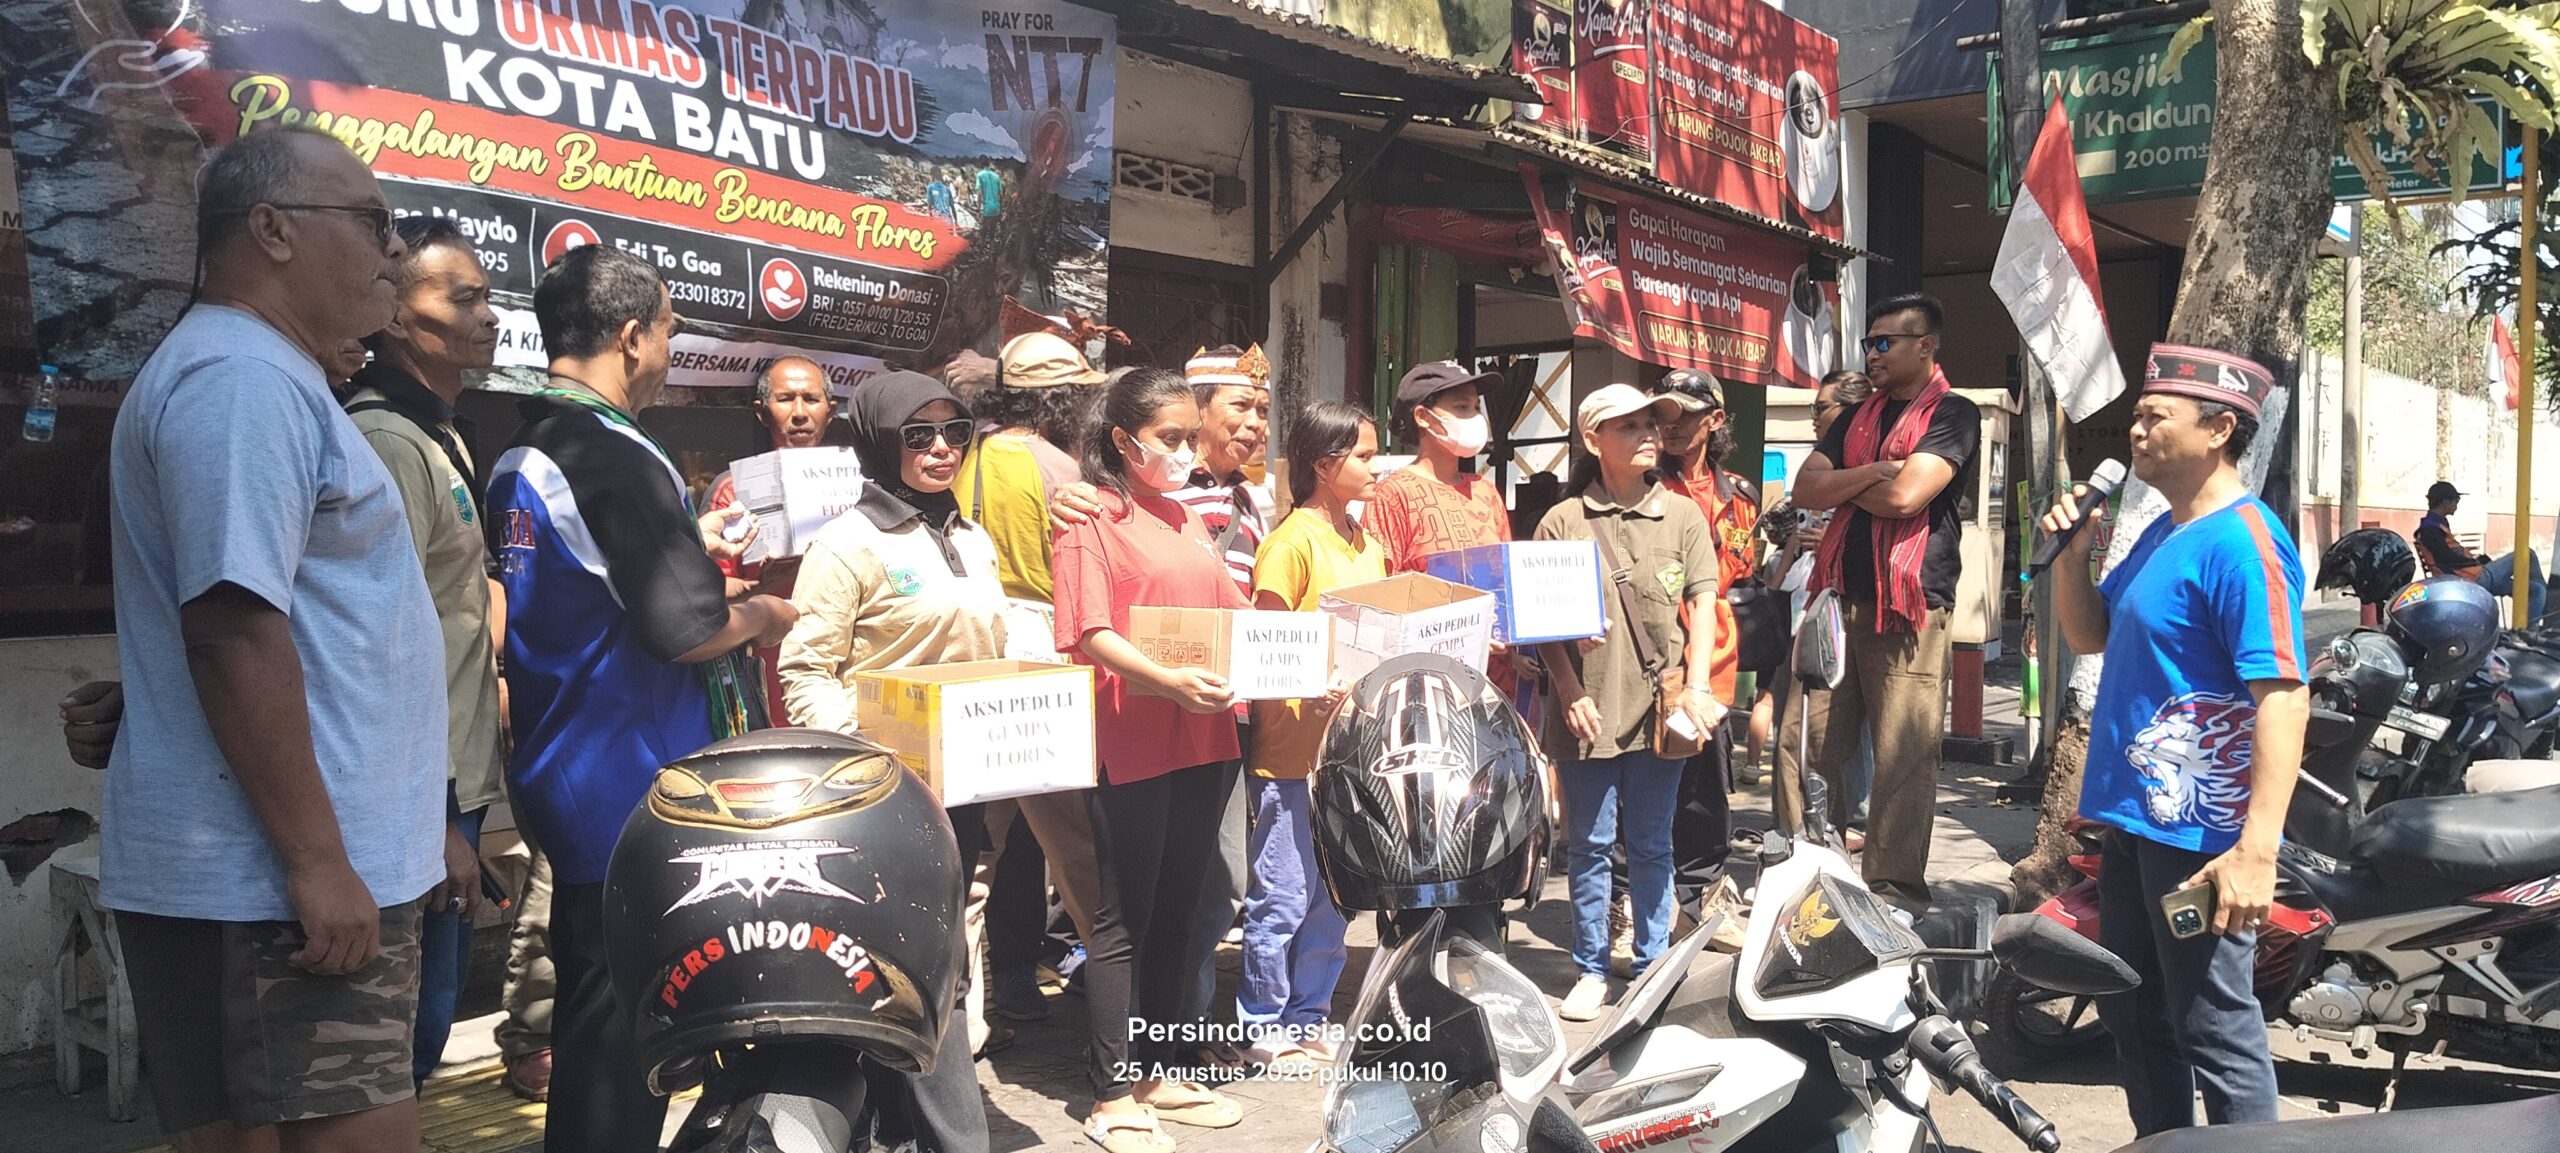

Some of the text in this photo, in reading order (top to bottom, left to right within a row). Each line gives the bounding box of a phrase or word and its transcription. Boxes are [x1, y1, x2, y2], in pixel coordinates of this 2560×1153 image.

[981, 10, 1054, 31] PRAY FOR
[1656, 0, 1734, 48] Gapai Harapan
[497, 0, 918, 143] ORMAS TERPADU
[1656, 27, 1784, 102] Wajib Semangat Seharian
[1657, 61, 1745, 117] Bareng Kapal Api
[442, 42, 825, 180] KOTA BATU
[2085, 103, 2211, 138] Khaldun
[1666, 107, 1781, 169] WARUNG POJOK AKBAR
[555, 132, 707, 208] Bantuan
[713, 168, 846, 238] Bencana
[851, 204, 938, 259] Flores
[1629, 207, 1725, 253] Gapai Harapan
[652, 245, 677, 269] To
[682, 251, 722, 276] Goa
[1630, 238, 1787, 297] Wajib Semangat Seharian
[813, 266, 884, 302] Rekening
[1632, 271, 1741, 317] Bareng Kapal Api
[812, 294, 834, 311] BRI
[890, 324, 904, 339] TO
[1646, 321, 1697, 350] WARUNG
[1698, 332, 1734, 356] POJOK
[1735, 342, 1767, 365] AKBAR
[671, 351, 751, 373] BERSAMA
[1246, 629, 1318, 644] AKSI PEDULI
[1417, 622, 1442, 640] AKSI
[1444, 613, 1481, 633] PEDULI
[1430, 637, 1465, 654] GEMPA
[961, 692, 1074, 720] AKSI PEDULI
[988, 721, 1051, 743] GEMPA
[986, 747, 1056, 769] FLORES
[682, 839, 838, 857] COMUNITAS METAL BERSATU
[661, 920, 875, 1009] PERS INDONESIA
